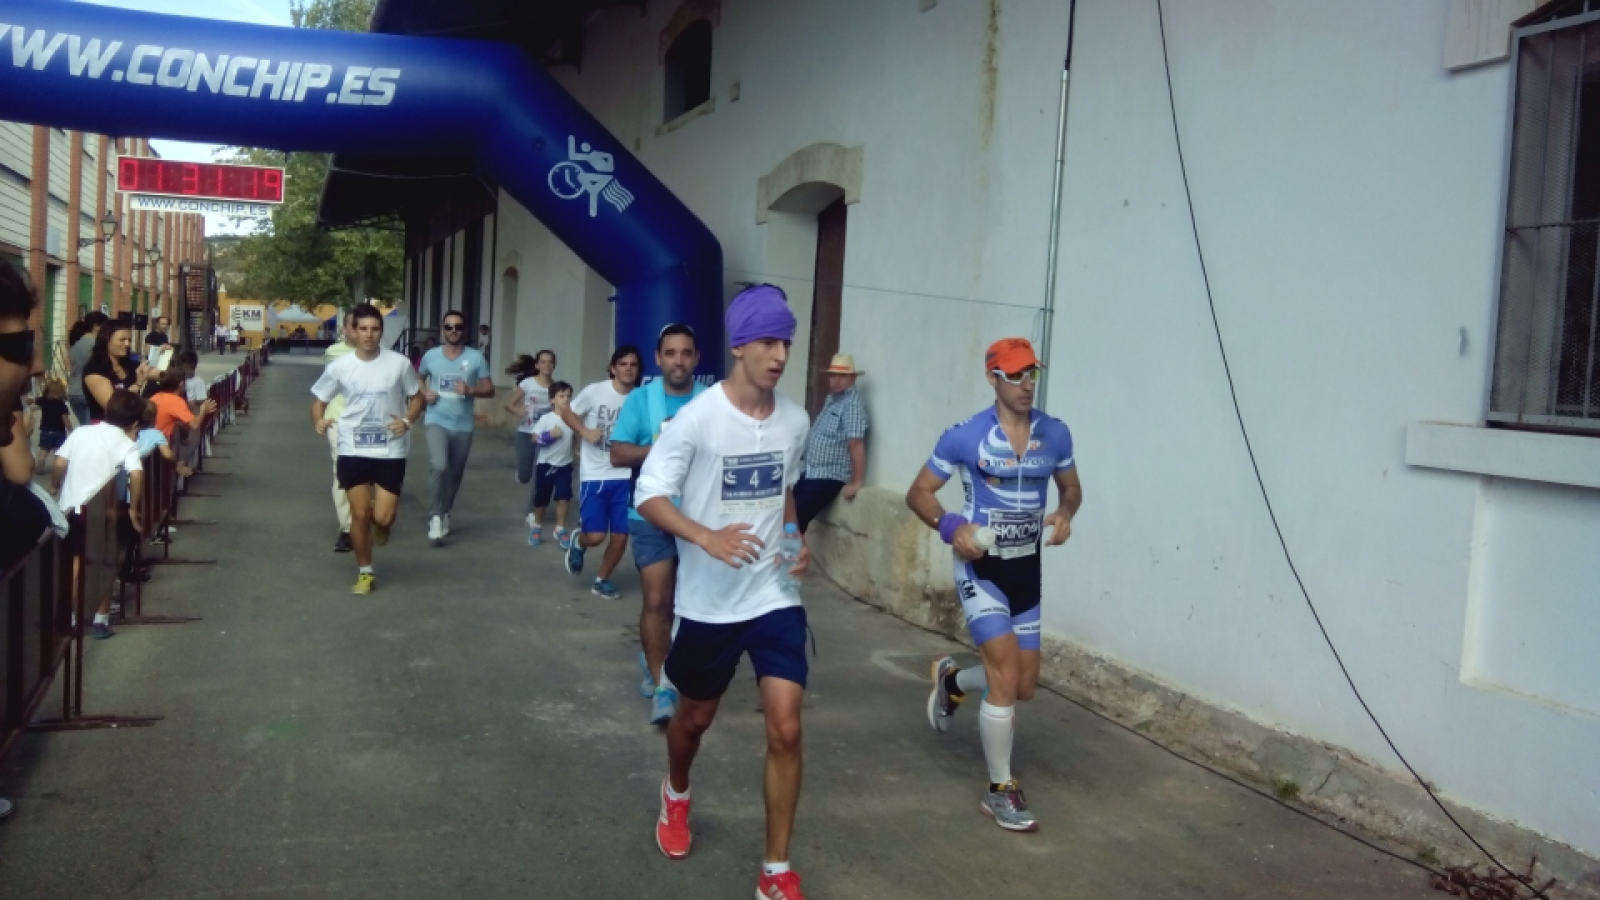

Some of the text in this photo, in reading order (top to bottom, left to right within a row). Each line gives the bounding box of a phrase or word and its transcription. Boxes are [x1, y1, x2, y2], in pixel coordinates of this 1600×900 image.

[138, 197, 268, 216] WWW.CONCHIP.ES
[242, 309, 261, 319] KM
[749, 469, 760, 488] 4
